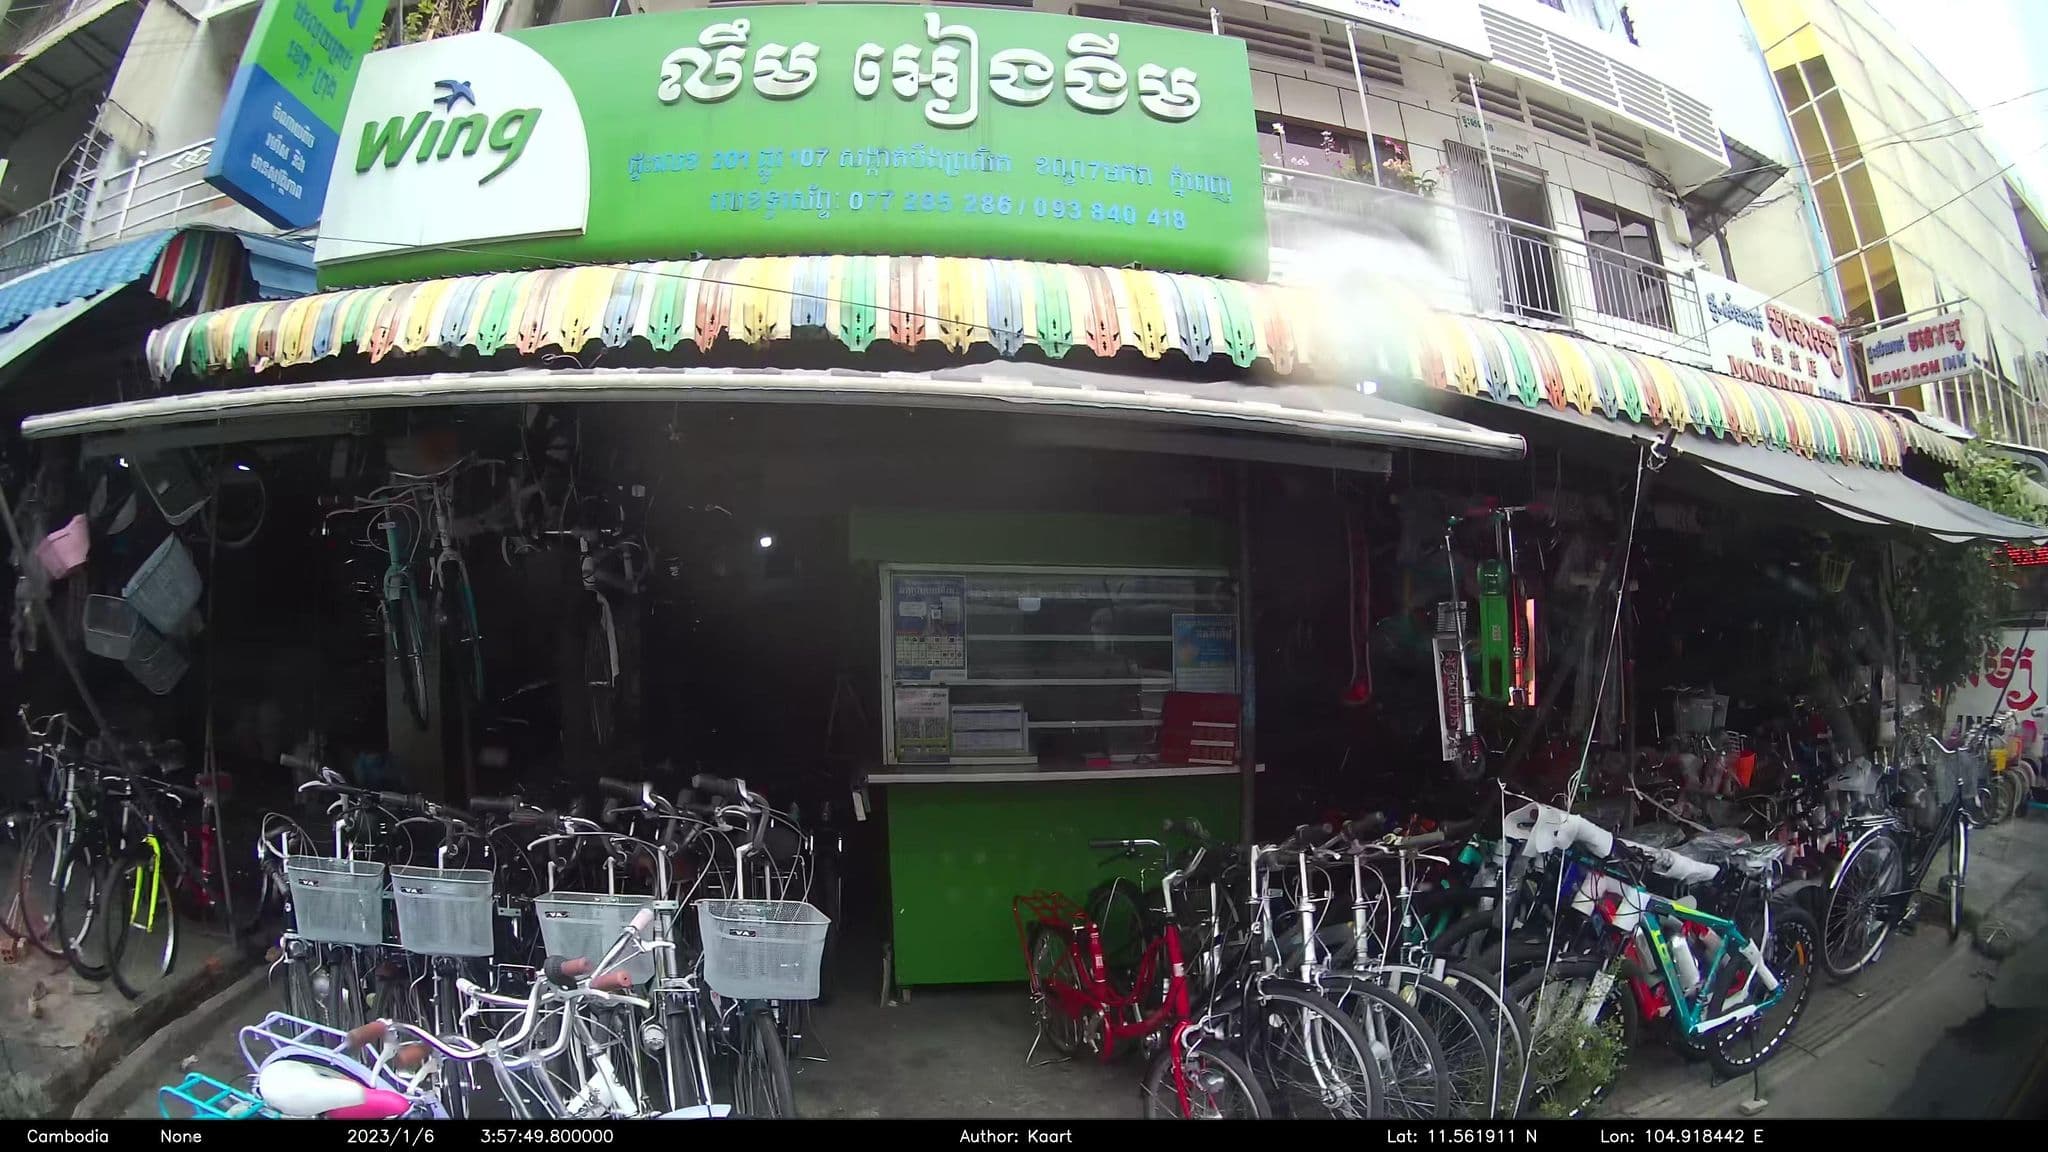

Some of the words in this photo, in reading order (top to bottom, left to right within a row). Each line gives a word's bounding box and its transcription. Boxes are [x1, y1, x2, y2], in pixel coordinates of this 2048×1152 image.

[658, 18, 820, 104] លឹម
[711, 150, 751, 170] 201
[790, 148, 831, 168] 107
[849, 190, 895, 211] 077
[1147, 208, 1187, 230] 418
[1727, 354, 1815, 395] MONOROM
[1872, 359, 1941, 389] MONOROM
[1942, 353, 1968, 372] INN
